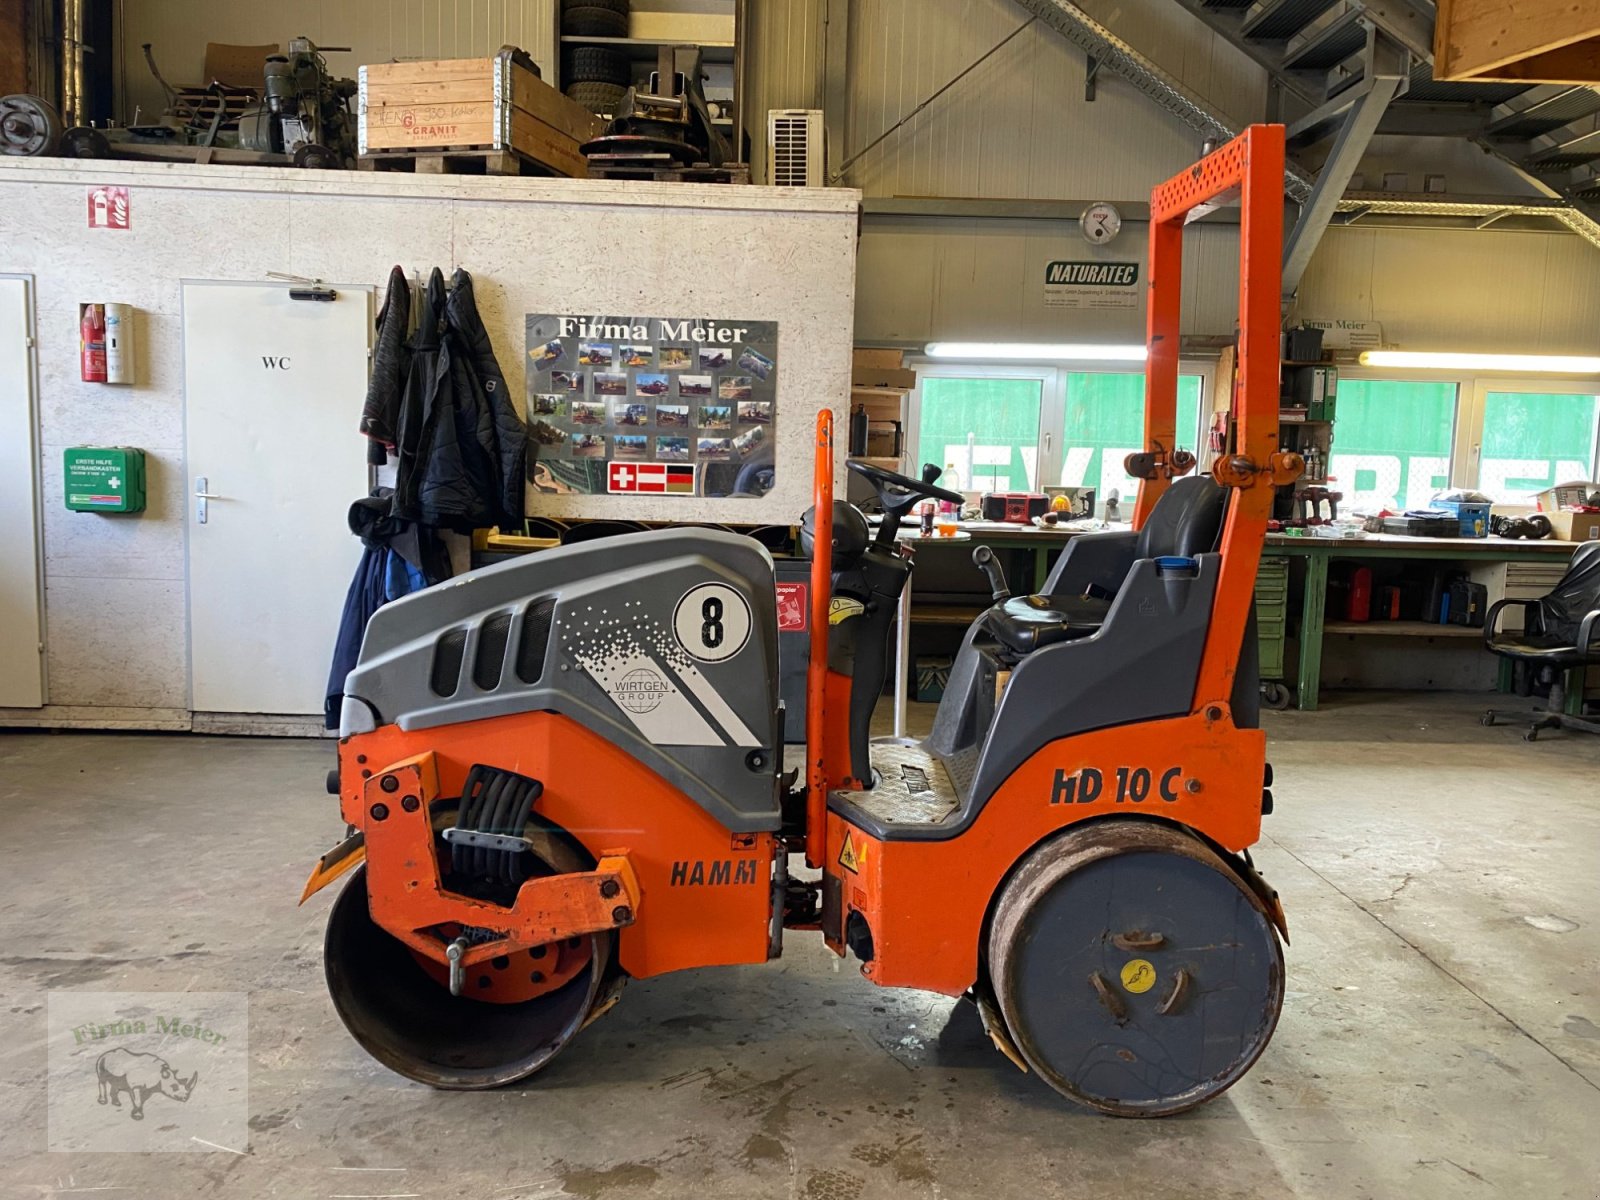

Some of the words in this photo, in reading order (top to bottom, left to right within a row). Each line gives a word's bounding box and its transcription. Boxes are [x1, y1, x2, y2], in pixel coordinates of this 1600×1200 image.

[412, 126, 457, 136] GRANIT
[1049, 264, 1135, 284] NATURATEC
[557, 317, 648, 341] Firma
[659, 320, 748, 344] Meier
[1336, 320, 1366, 330] Meier
[262, 356, 291, 370] WC
[701, 596, 724, 649] 8
[615, 681, 669, 691] WIRTGEN
[618, 692, 664, 701] GROUP
[1050, 767, 1103, 804] HD
[1115, 767, 1151, 803] 10
[1160, 767, 1182, 803] C
[670, 859, 757, 886] HAMM
